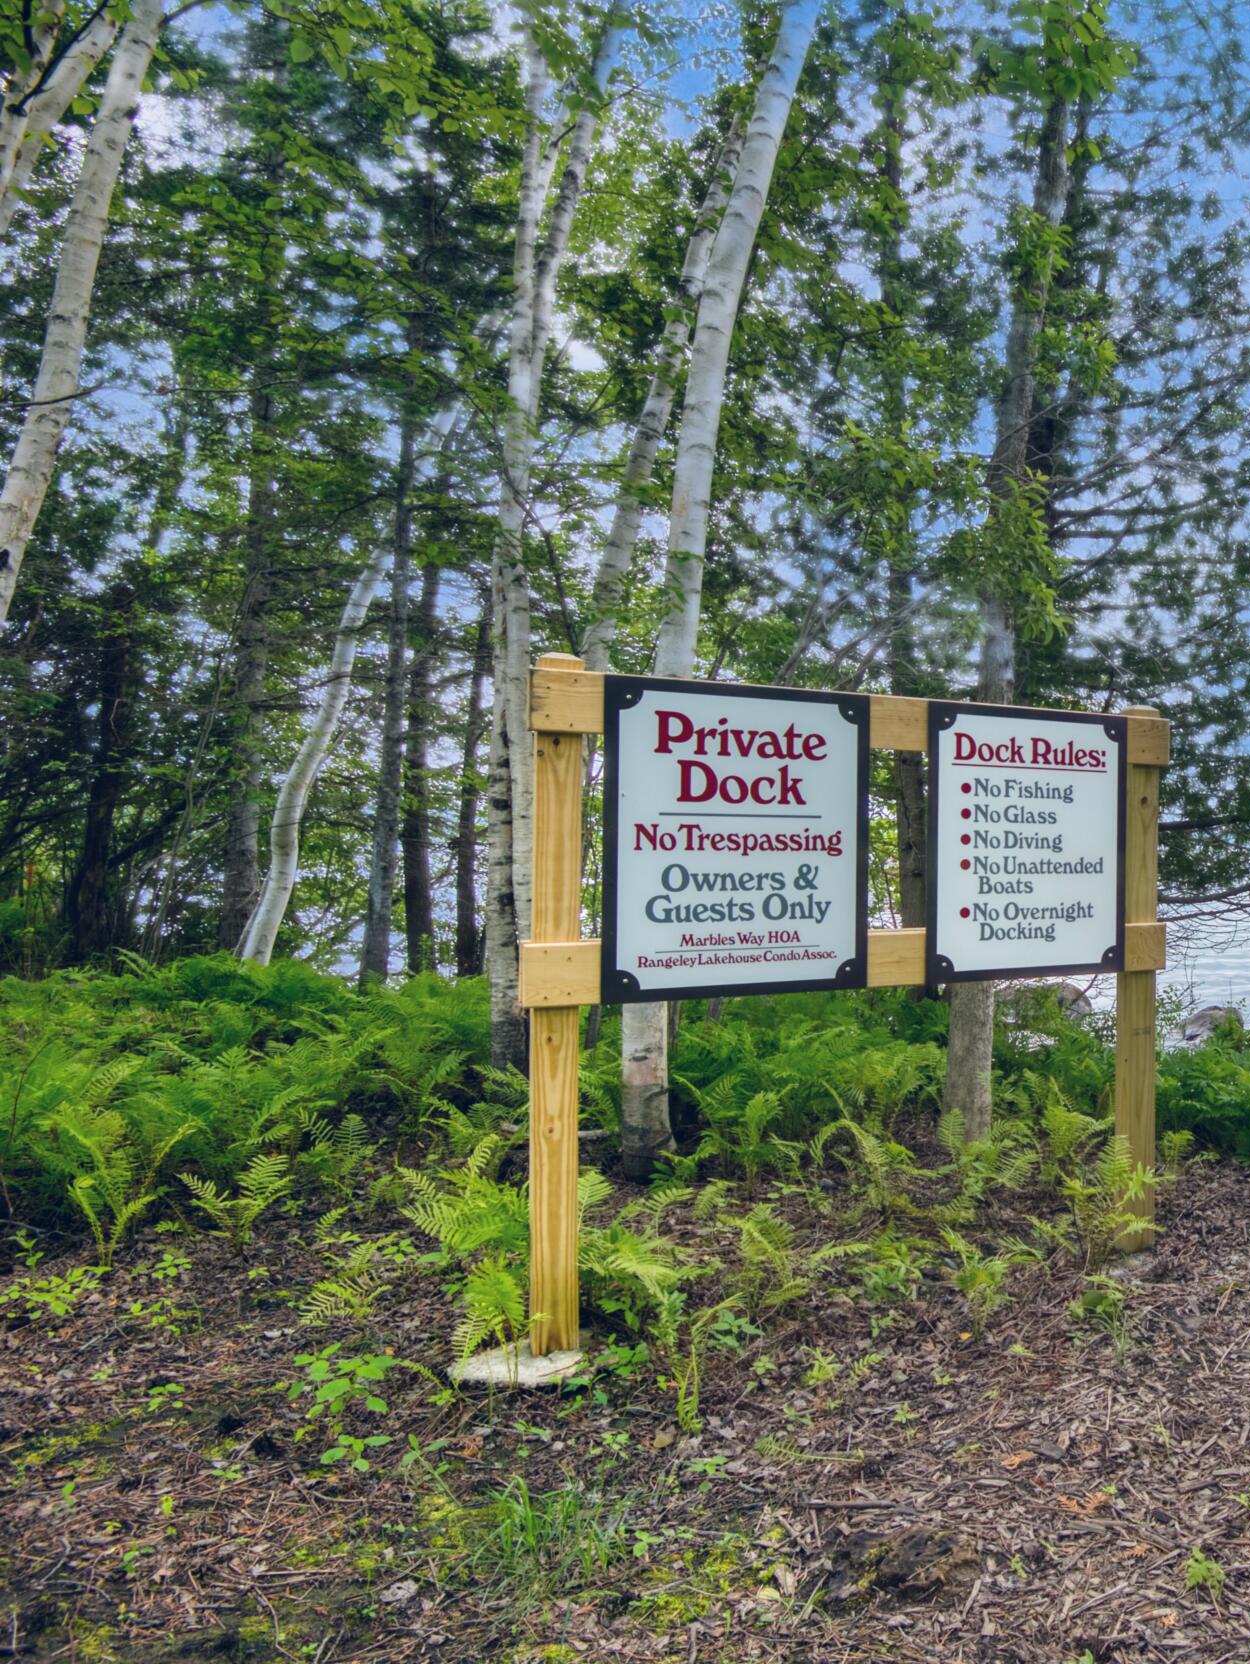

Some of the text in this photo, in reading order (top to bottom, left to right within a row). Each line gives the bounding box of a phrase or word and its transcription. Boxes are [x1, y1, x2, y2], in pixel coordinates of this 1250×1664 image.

[654, 710, 828, 761] Private
[953, 732, 1107, 768] Dock Rules:
[676, 759, 807, 805] Dock
[973, 778, 1074, 803] No Fishing
[973, 804, 1057, 824] No Glass
[633, 823, 843, 856] No Trespassing
[973, 830, 1063, 852] No Diving
[972, 856, 1104, 875] No Unattended
[661, 863, 819, 892] Owners &
[978, 876, 1034, 894] Boats
[645, 893, 831, 924] Guests Only
[972, 901, 1094, 922] No Overnight
[680, 931, 801, 947] Marbles Way HOA
[979, 922, 1056, 942] Docking
[637, 949, 837, 969] Rangeley Lakehouse Condo Assoc.
